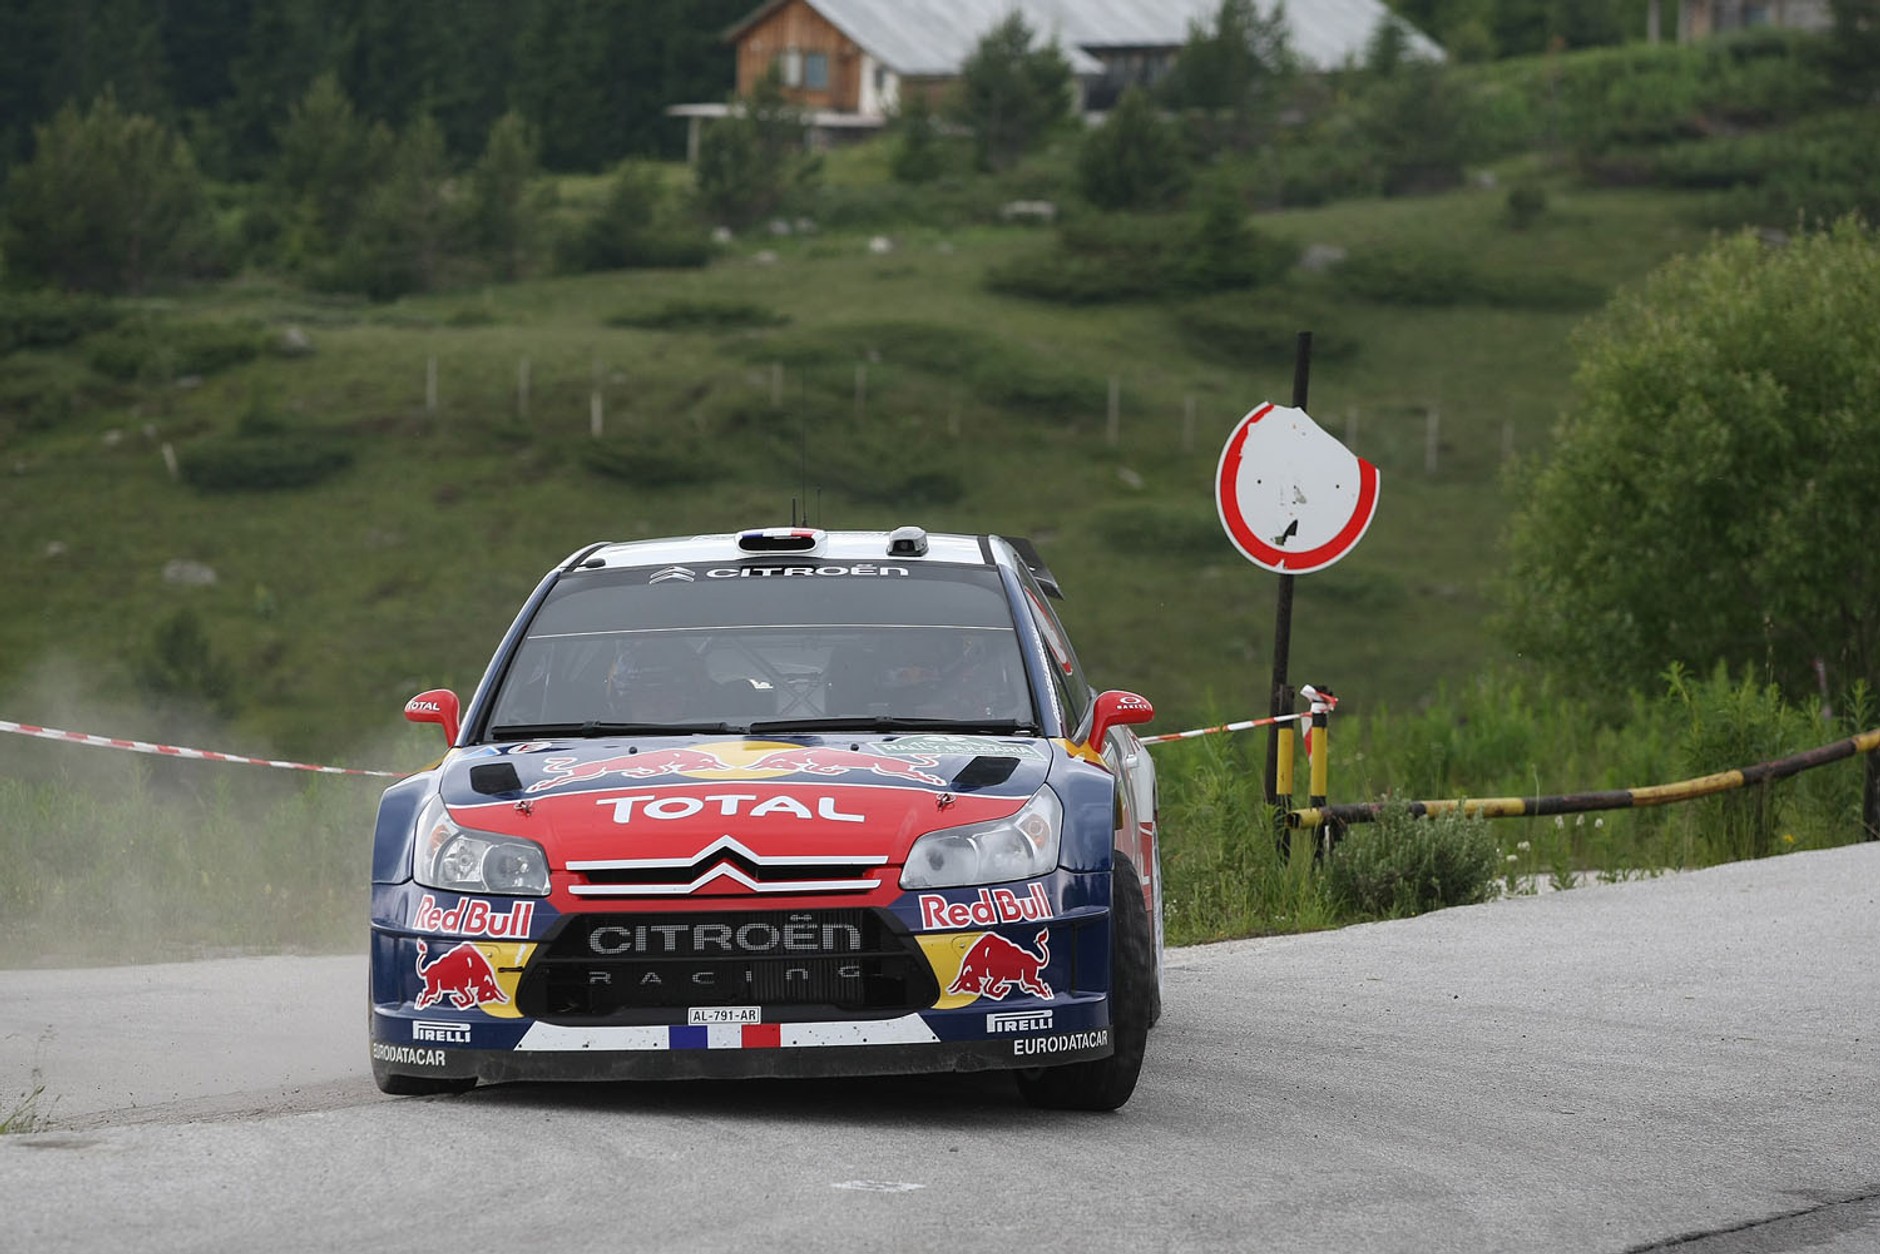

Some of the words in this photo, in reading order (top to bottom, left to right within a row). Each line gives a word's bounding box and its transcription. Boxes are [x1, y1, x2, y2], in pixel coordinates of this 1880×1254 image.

[596, 795, 865, 824] TOTAL
[413, 895, 470, 934] Red
[462, 900, 535, 938] Bull
[919, 888, 998, 930] Red
[992, 882, 1053, 923] Bull
[693, 1010, 756, 1022] AL-791-AR
[986, 1009, 1053, 1033] PIRELLI
[413, 1020, 471, 1043] PIRELLI
[1013, 1030, 1108, 1055] EURODATACAR
